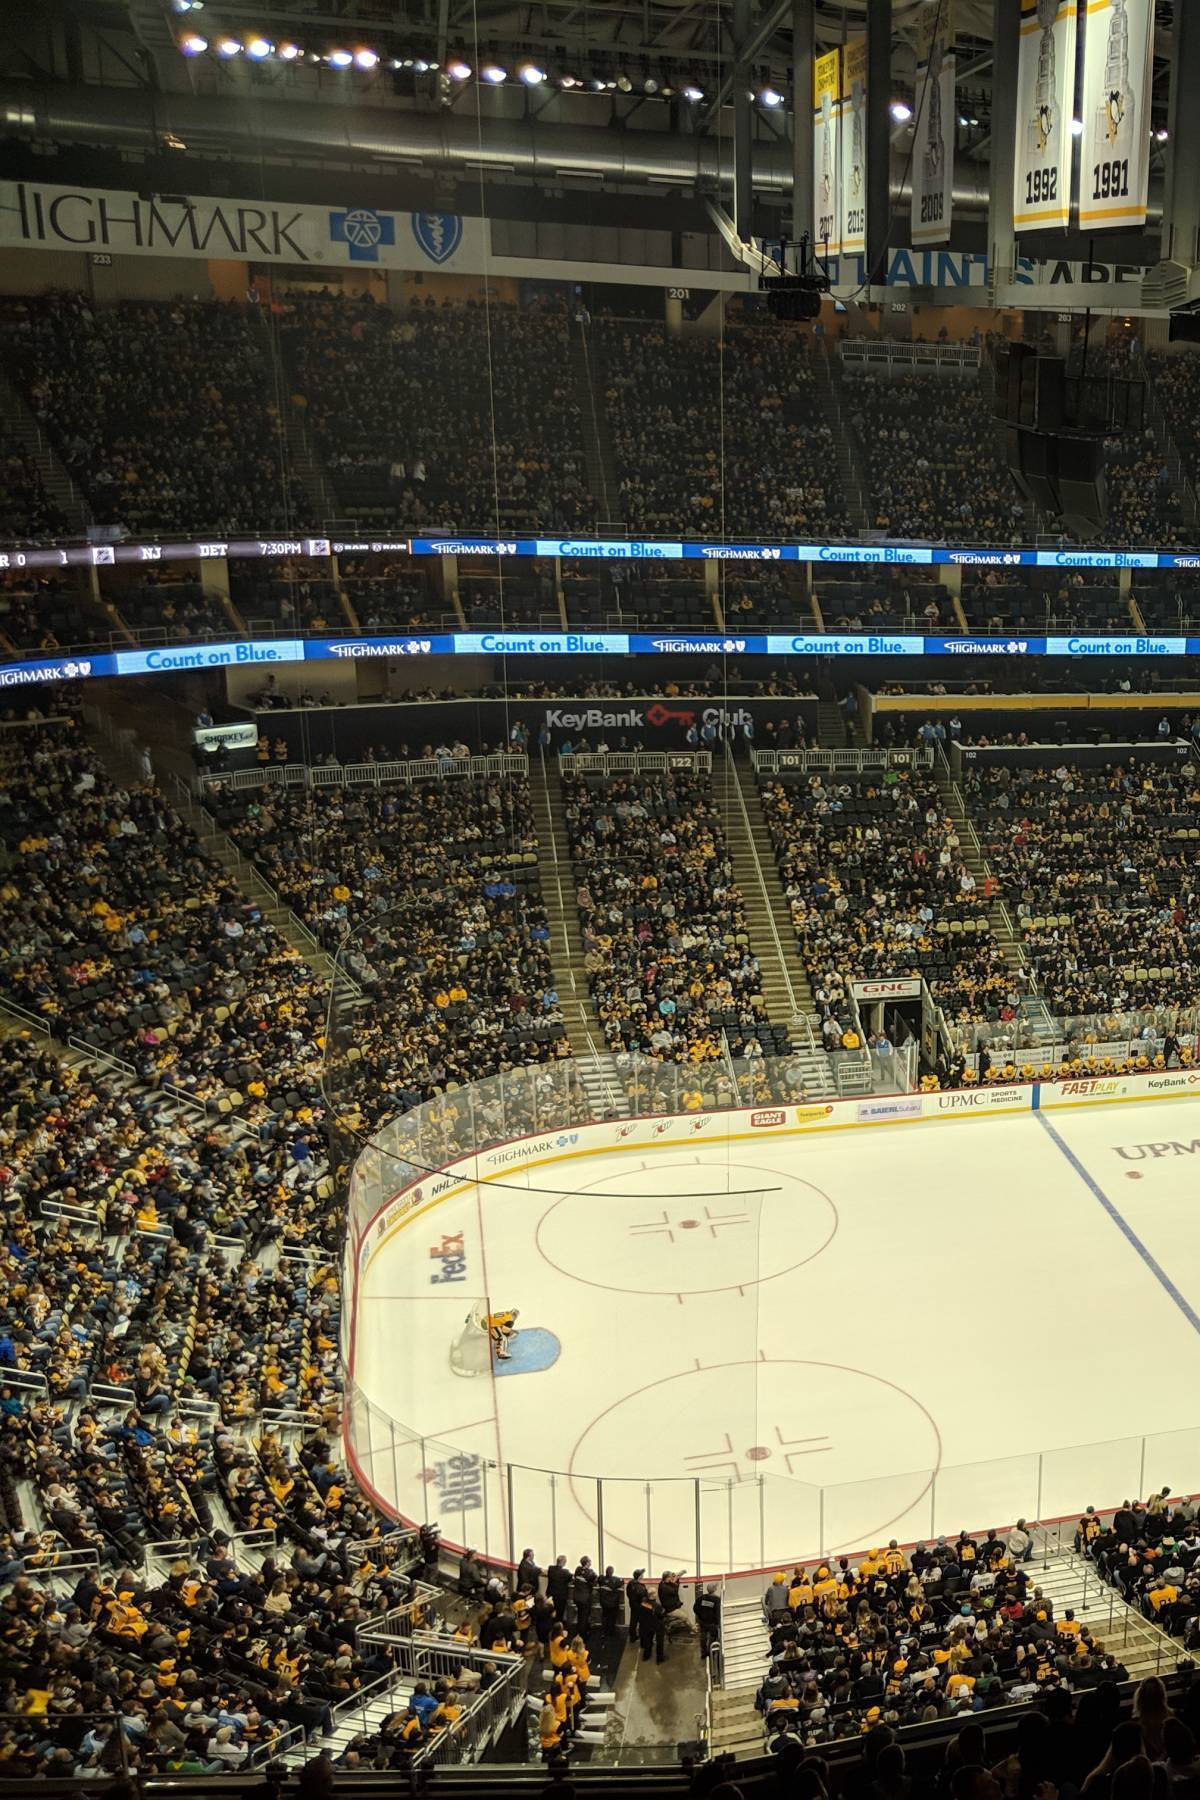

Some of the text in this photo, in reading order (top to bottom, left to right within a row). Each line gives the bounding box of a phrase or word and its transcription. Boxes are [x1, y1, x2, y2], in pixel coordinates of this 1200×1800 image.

[1025, 167, 1058, 204] 1992
[1092, 159, 1129, 200] 1991
[669, 289, 690, 299] 201
[142, 547, 161, 560] NJ
[200, 544, 227, 557] DET
[261, 542, 300, 556] 7:30PM
[437, 542, 495, 555] HIGHMARK
[559, 541, 666, 557] Count on Blue.
[708, 547, 760, 559] HIGHMARK
[819, 548, 916, 563] Count on Blue.
[955, 553, 1001, 565] HIGHMARK
[1055, 553, 1091, 567] Count
[1096, 556, 1111, 567] on
[337, 643, 404, 657] HIGHMARK
[481, 636, 609, 653] Count on Blue.
[660, 639, 721, 653] HIGHMARK
[792, 637, 906, 653] Count on Blue.
[950, 641, 1006, 654] HIGHMARK
[1067, 639, 1169, 654] Count on Blue.
[146, 645, 282, 671] Count on Blue.
[546, 707, 753, 732] KeyBank Club
[1176, 747, 1187, 755] 102
[671, 757, 692, 768] 122
[783, 755, 799, 766] 101
[893, 754, 910, 764] 101
[863, 983, 913, 993] GNC
[1148, 1077, 1187, 1089] KeyBank
[991, 1089, 1017, 1099] SPORTS
[991, 1094, 1022, 1104] MEDICINE
[939, 1093, 985, 1109] UPMC
[753, 1112, 783, 1120] GIANT
[754, 1119, 783, 1127] EAGLE
[493, 1140, 554, 1165] HIGHMARK
[430, 1230, 466, 1284] FedEx
[439, 1453, 483, 1515] Blue
